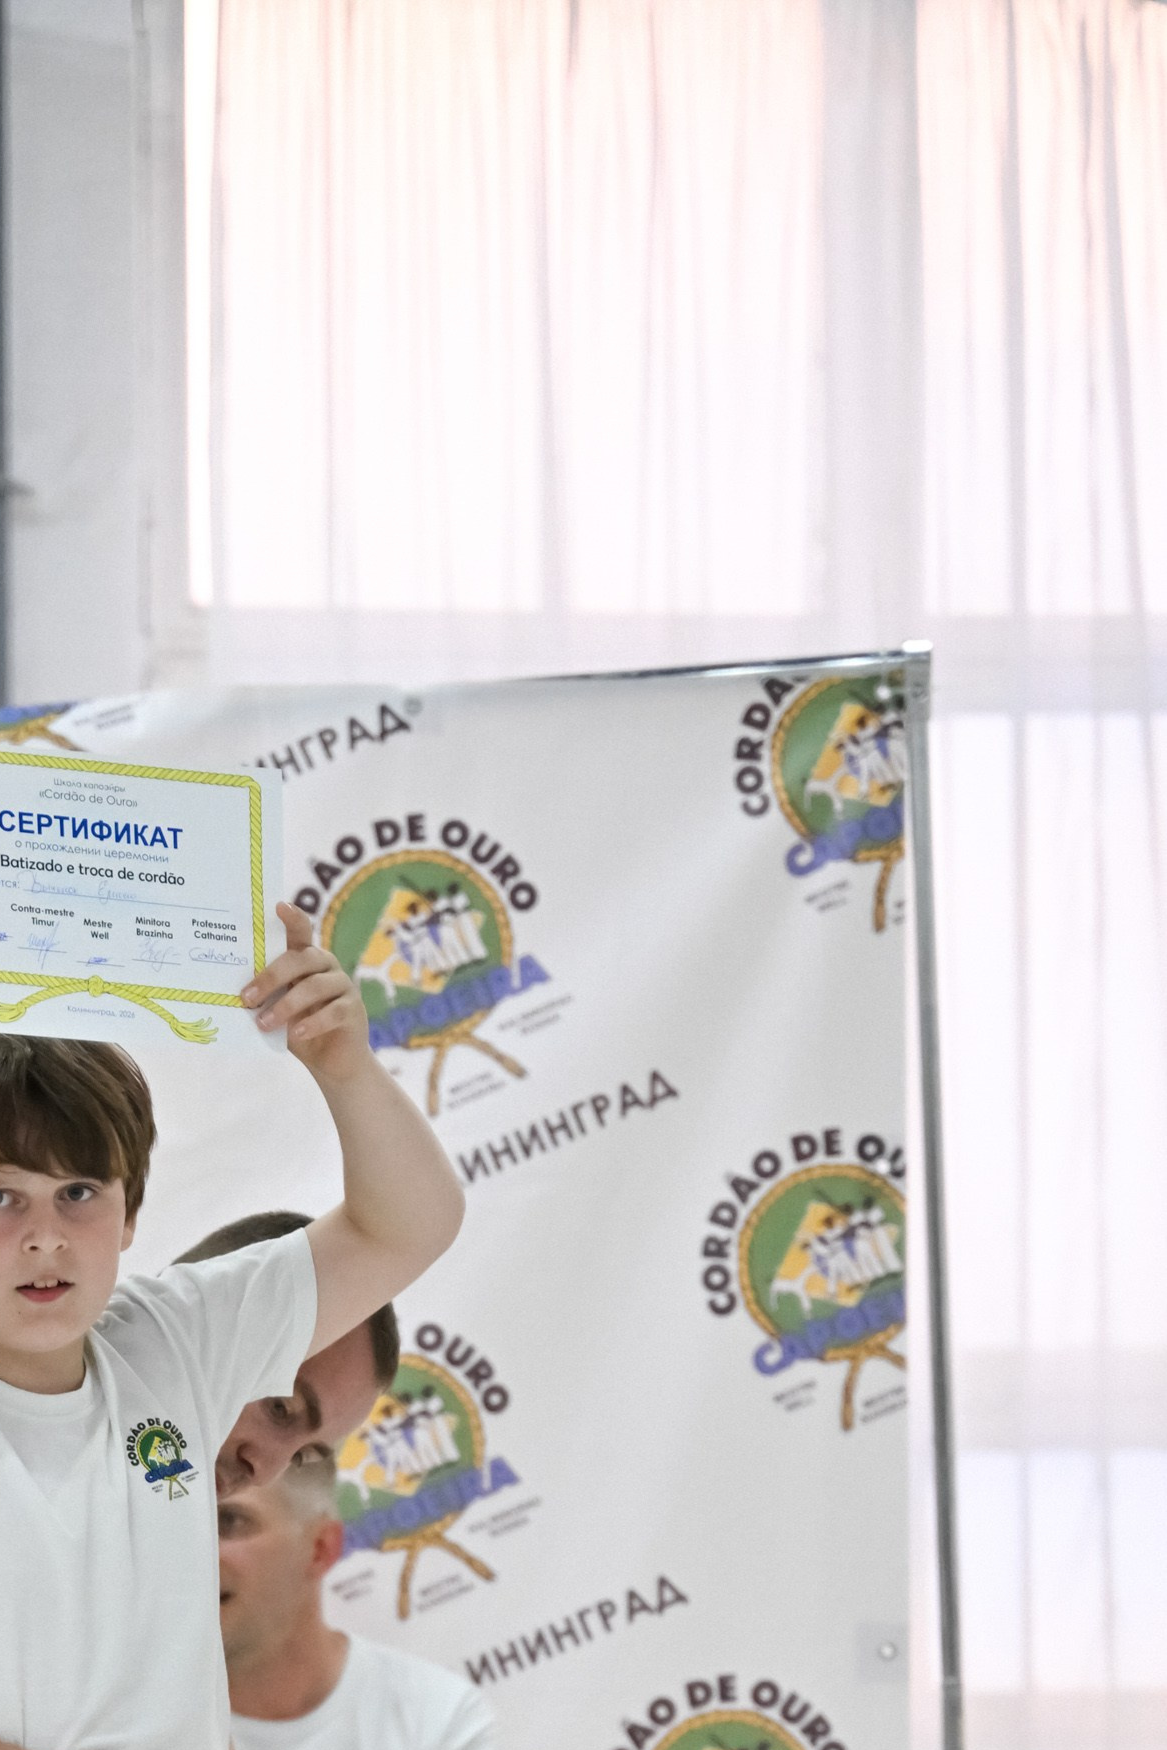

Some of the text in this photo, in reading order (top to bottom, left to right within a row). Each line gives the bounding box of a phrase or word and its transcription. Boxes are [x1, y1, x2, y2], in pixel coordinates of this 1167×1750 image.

[53, 778, 82, 788] Школа
[89, 793, 103, 804] de
[25, 841, 101, 857] прохождении
[104, 849, 169, 864] церемонии
[0, 854, 185, 886] Batizado e troca de cordão
[294, 813, 540, 917] DÃO DE OURO
[31, 917, 55, 927] Timur
[83, 918, 113, 929] Mestre
[191, 918, 236, 931] Professora
[90, 931, 109, 941] Well
[136, 928, 174, 940] Brazinha
[194, 931, 238, 943] Catharina
[458, 1069, 681, 1184] ИНИНГРАД
[702, 1150, 781, 1317] CORDÃO
[790, 1128, 843, 1162] DE
[415, 1322, 510, 1416] OURO
[126, 1417, 187, 1467] CORDÃO DE OURO
[464, 1574, 690, 1688] ИНИНГРАД
[685, 1675, 738, 1709] DE
